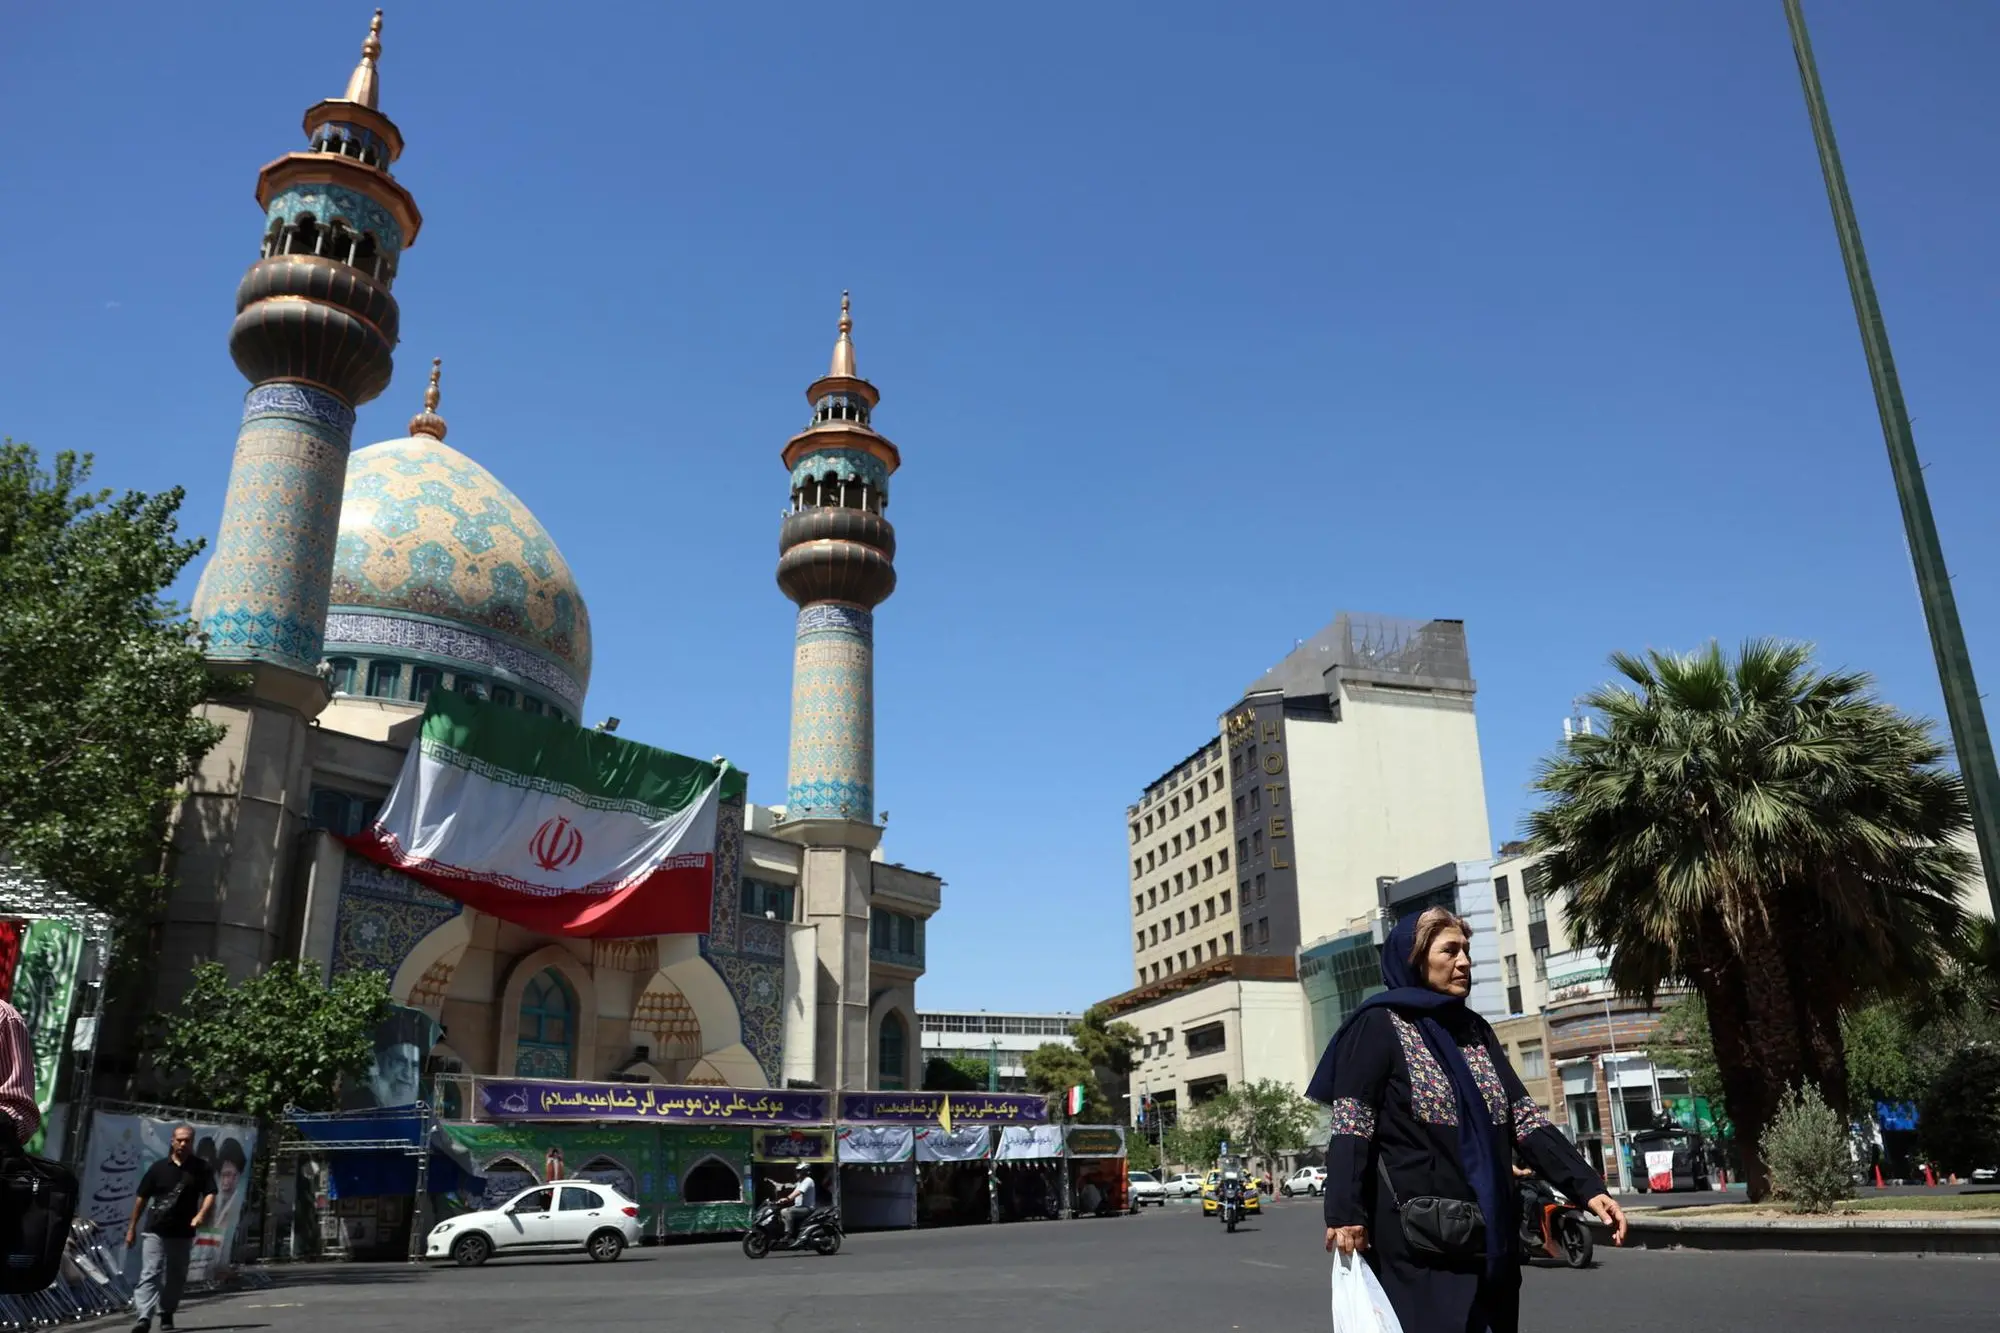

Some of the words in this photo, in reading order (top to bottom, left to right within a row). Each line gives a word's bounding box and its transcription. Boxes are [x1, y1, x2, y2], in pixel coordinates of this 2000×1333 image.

[1261, 720, 1289, 869] HOTEL
[656, 1097, 702, 1116] موسی
[703, 1095, 721, 1116] بن
[721, 1093, 748, 1117] علی
[747, 1096, 784, 1119] موکب
